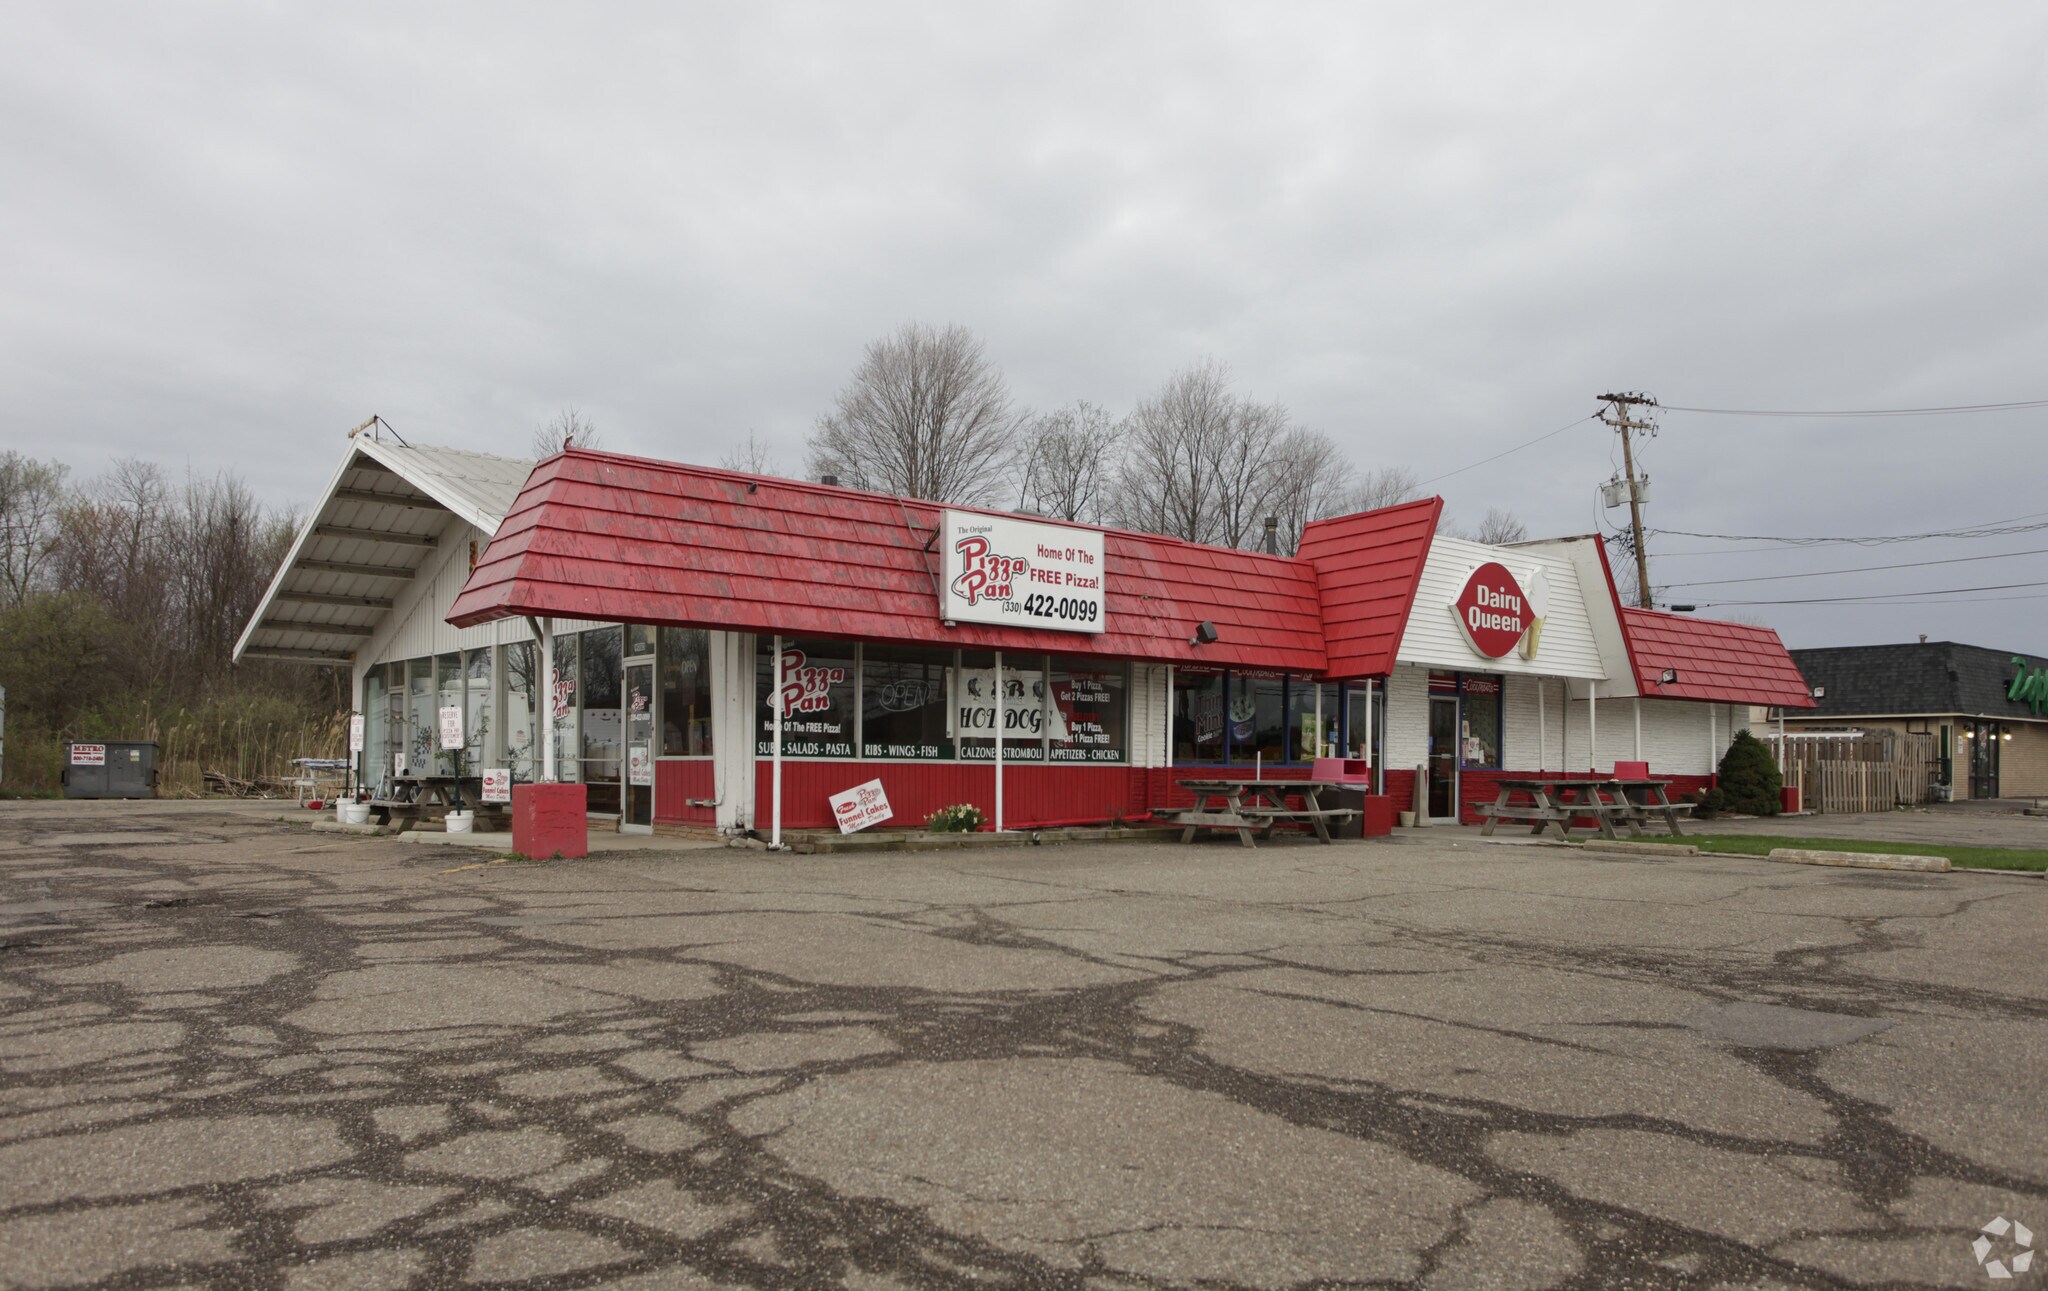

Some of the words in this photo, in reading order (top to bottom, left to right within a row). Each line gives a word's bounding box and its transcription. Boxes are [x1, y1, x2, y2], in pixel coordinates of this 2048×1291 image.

[958, 526, 968, 534] The
[969, 525, 993, 534] Original
[957, 537, 1025, 582] Pizza
[1037, 543, 1062, 561] Home
[1065, 548, 1075, 562] Of
[1077, 549, 1095, 565] The
[960, 569, 1012, 605] Pan
[1030, 568, 1062, 585] FREE
[1065, 573, 1099, 589] Pizza!
[1002, 601, 1022, 615] (330)
[1024, 593, 1098, 623] 422-0099
[1477, 584, 1521, 616] Dairy
[1468, 605, 1521, 632] Queen
[771, 650, 844, 693] Pizza
[881, 684, 928, 706] OPEN
[1071, 680, 1083, 691] Buy
[1083, 680, 1086, 689] 1
[1087, 680, 1103, 691] Pizza,
[780, 682, 830, 718] Pan
[1060, 691, 1071, 700] Get
[1071, 692, 1076, 701] 2
[1076, 692, 1094, 702] Pizzas
[1094, 693, 1110, 702] FREE!
[783, 721, 792, 731] Of
[793, 721, 805, 732] The
[806, 722, 822, 733] FREE
[823, 723, 841, 734] Pizza!
[1004, 708, 1053, 734] DOG
[1071, 722, 1083, 733] Buy
[1083, 722, 1086, 731] 1
[1087, 722, 1103, 733] Pizza,
[787, 742, 819, 755] SALADS
[825, 743, 851, 755] PASTA
[1074, 734, 1078, 742] 1
[1079, 734, 1094, 743] Pizza
[1094, 734, 1110, 744] FREE!
[864, 744, 882, 756] RIBS
[888, 744, 916, 757] WINGS
[920, 745, 938, 757] FISH
[961, 746, 997, 758] CALZONE
[1002, 747, 1042, 758] STROMBOLI
[1050, 748, 1086, 759] APPETIZERS
[1091, 749, 1120, 760] CHICKEN
[839, 809, 865, 826] Funnel
[865, 802, 888, 816] Cakes
